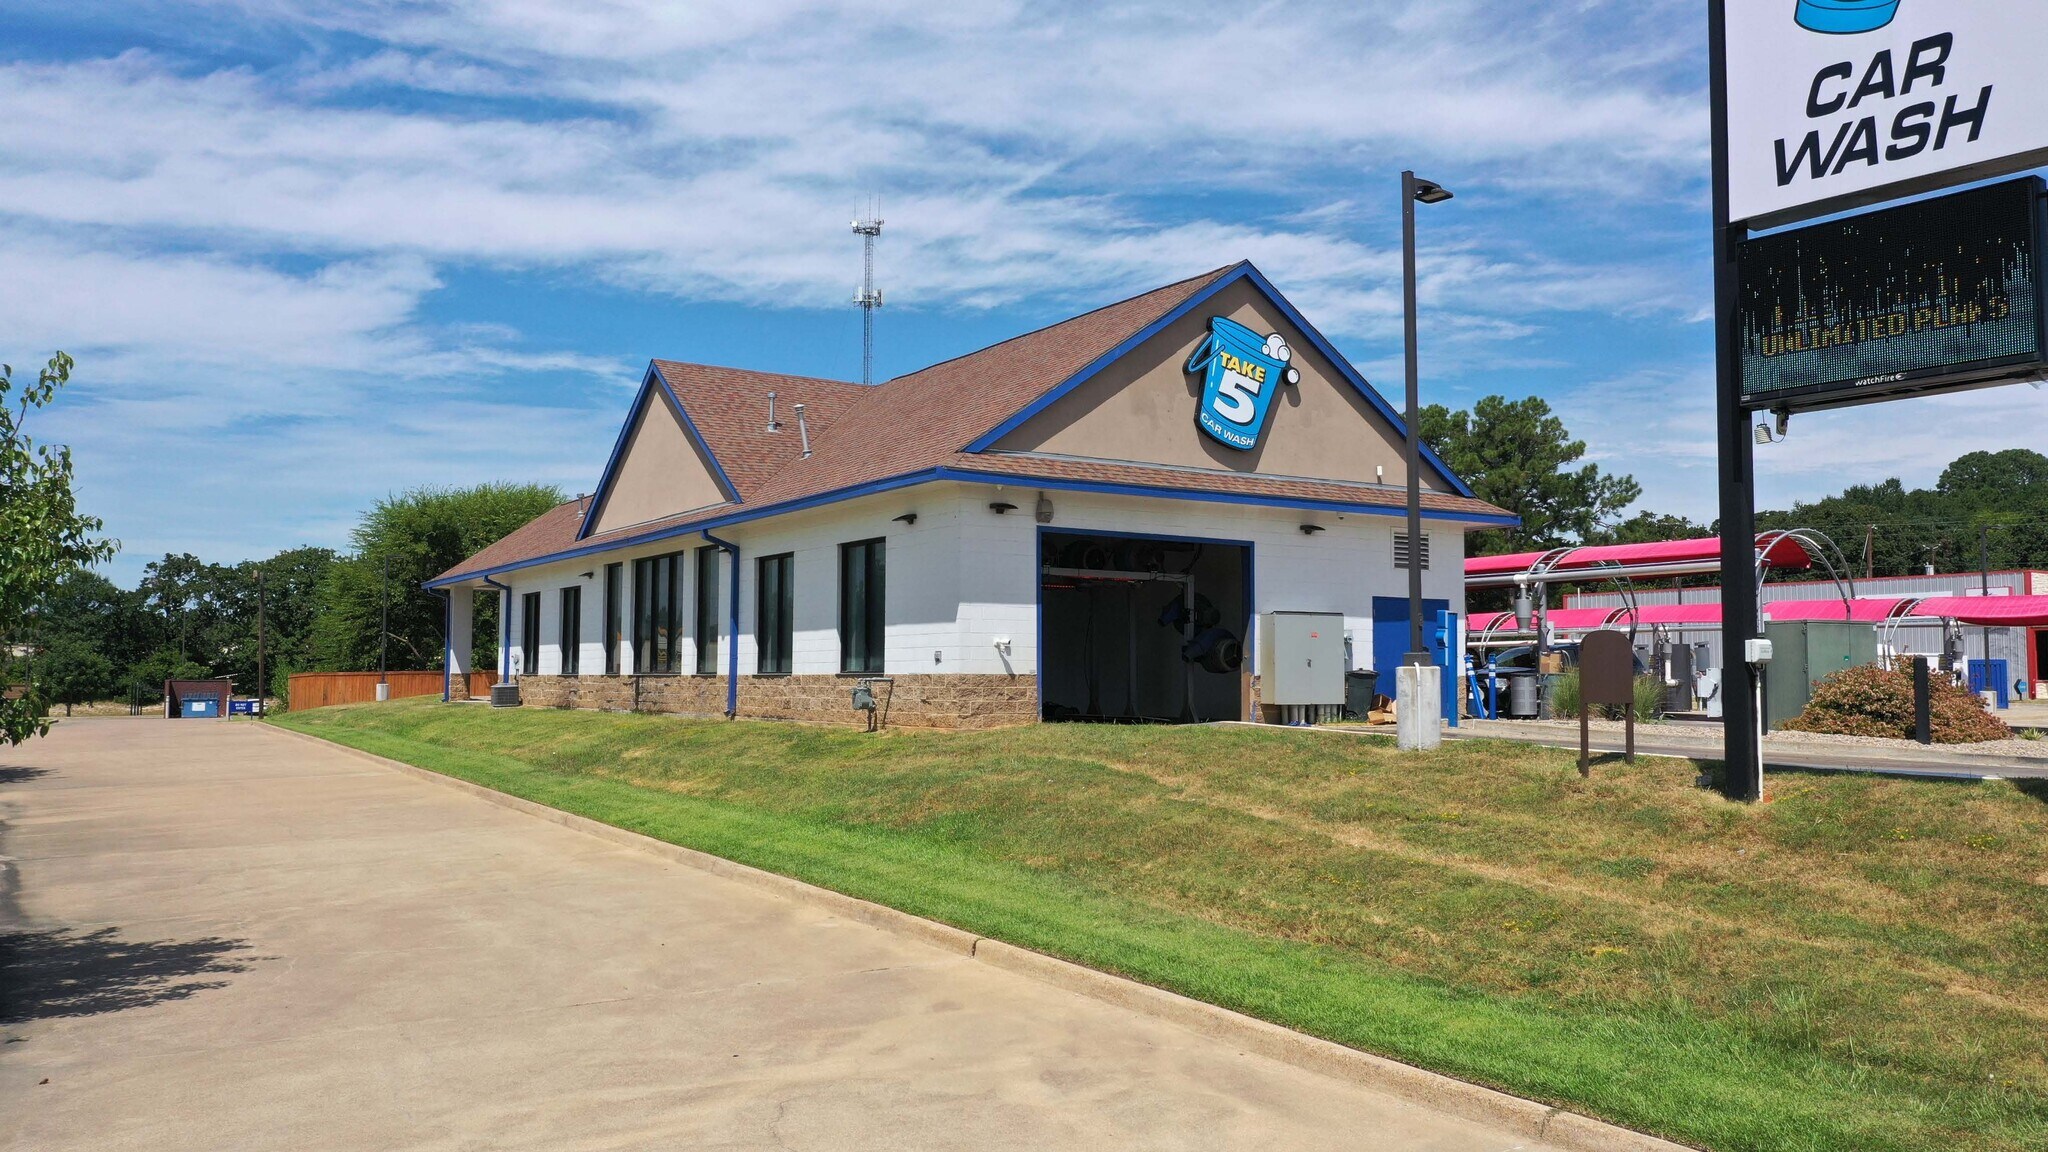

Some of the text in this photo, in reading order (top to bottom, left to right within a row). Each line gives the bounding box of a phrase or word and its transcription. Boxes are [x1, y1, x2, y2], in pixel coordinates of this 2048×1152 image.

[1806, 31, 1953, 118] CAR
[1774, 84, 1993, 187] WASH
[1762, 312, 1906, 356] UNLIMITED
[1220, 351, 1266, 383] TAKE
[1213, 369, 1260, 424] 5
[1201, 412, 1255, 446] CAR WASH
